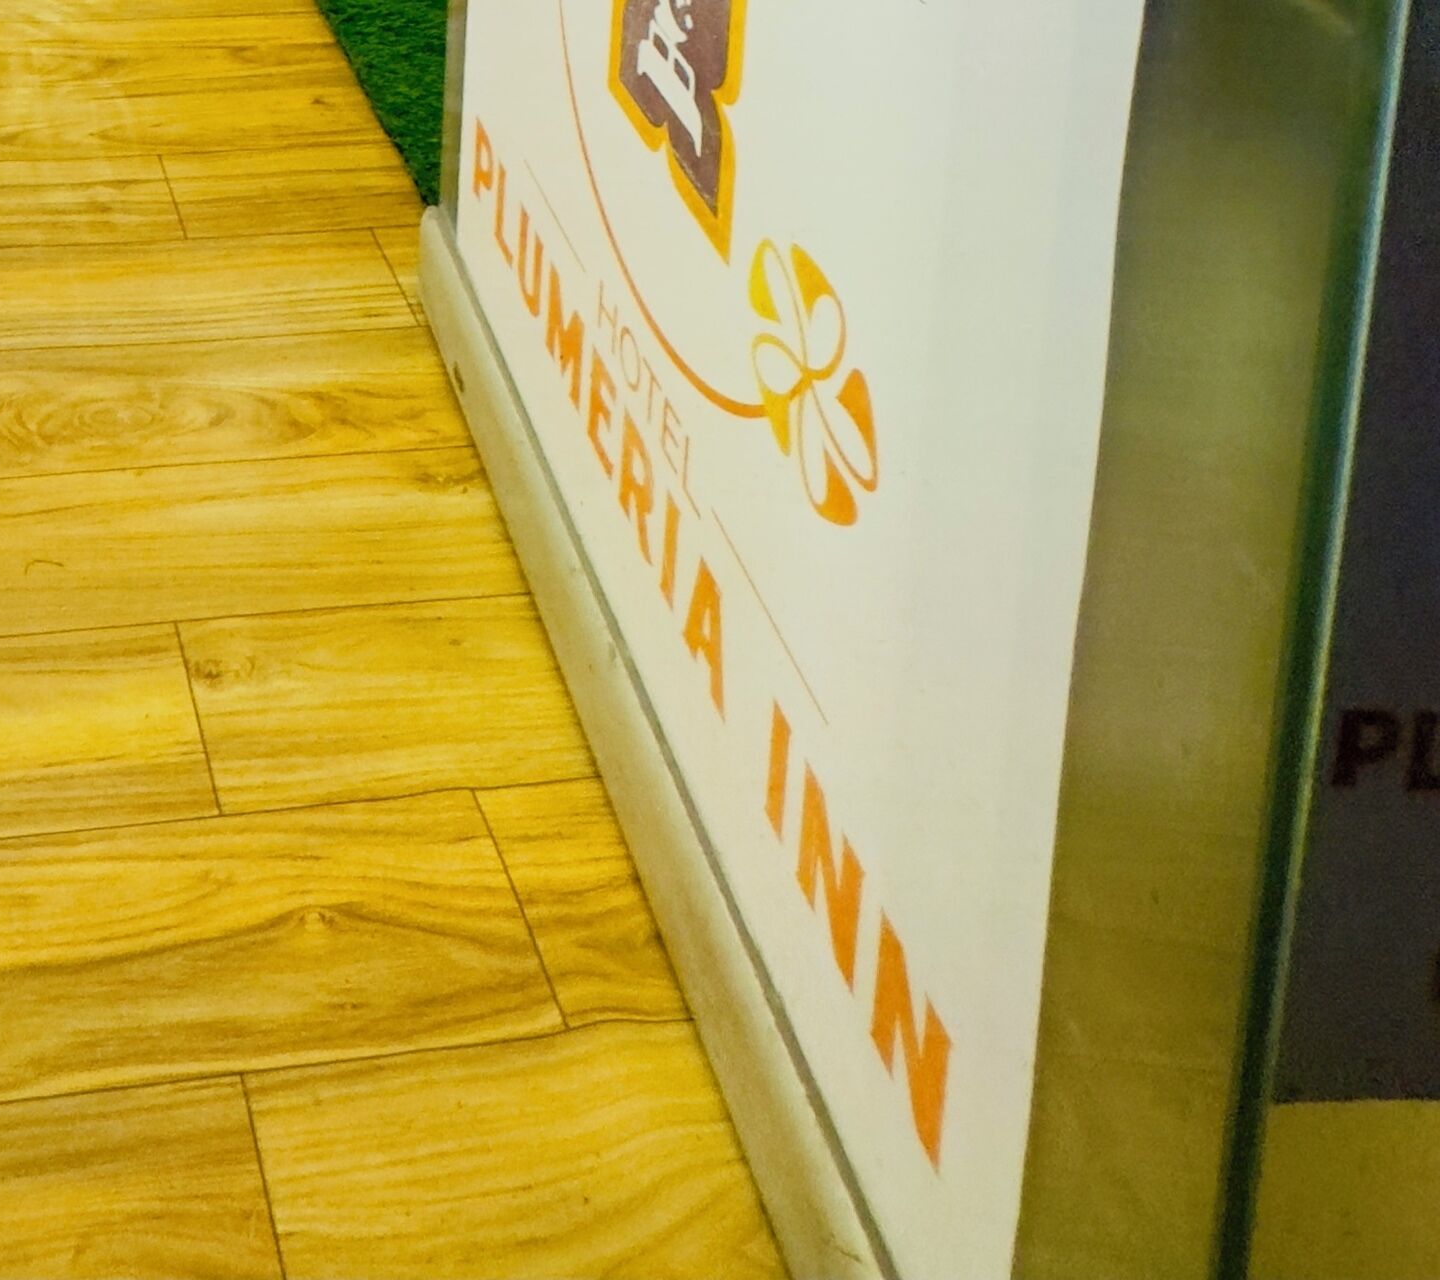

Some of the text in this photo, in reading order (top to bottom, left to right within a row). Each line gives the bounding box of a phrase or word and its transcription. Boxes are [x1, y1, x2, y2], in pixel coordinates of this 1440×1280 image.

[470, 117, 953, 1173] PLUMERIA INN
[597, 277, 702, 520] HOTEL
